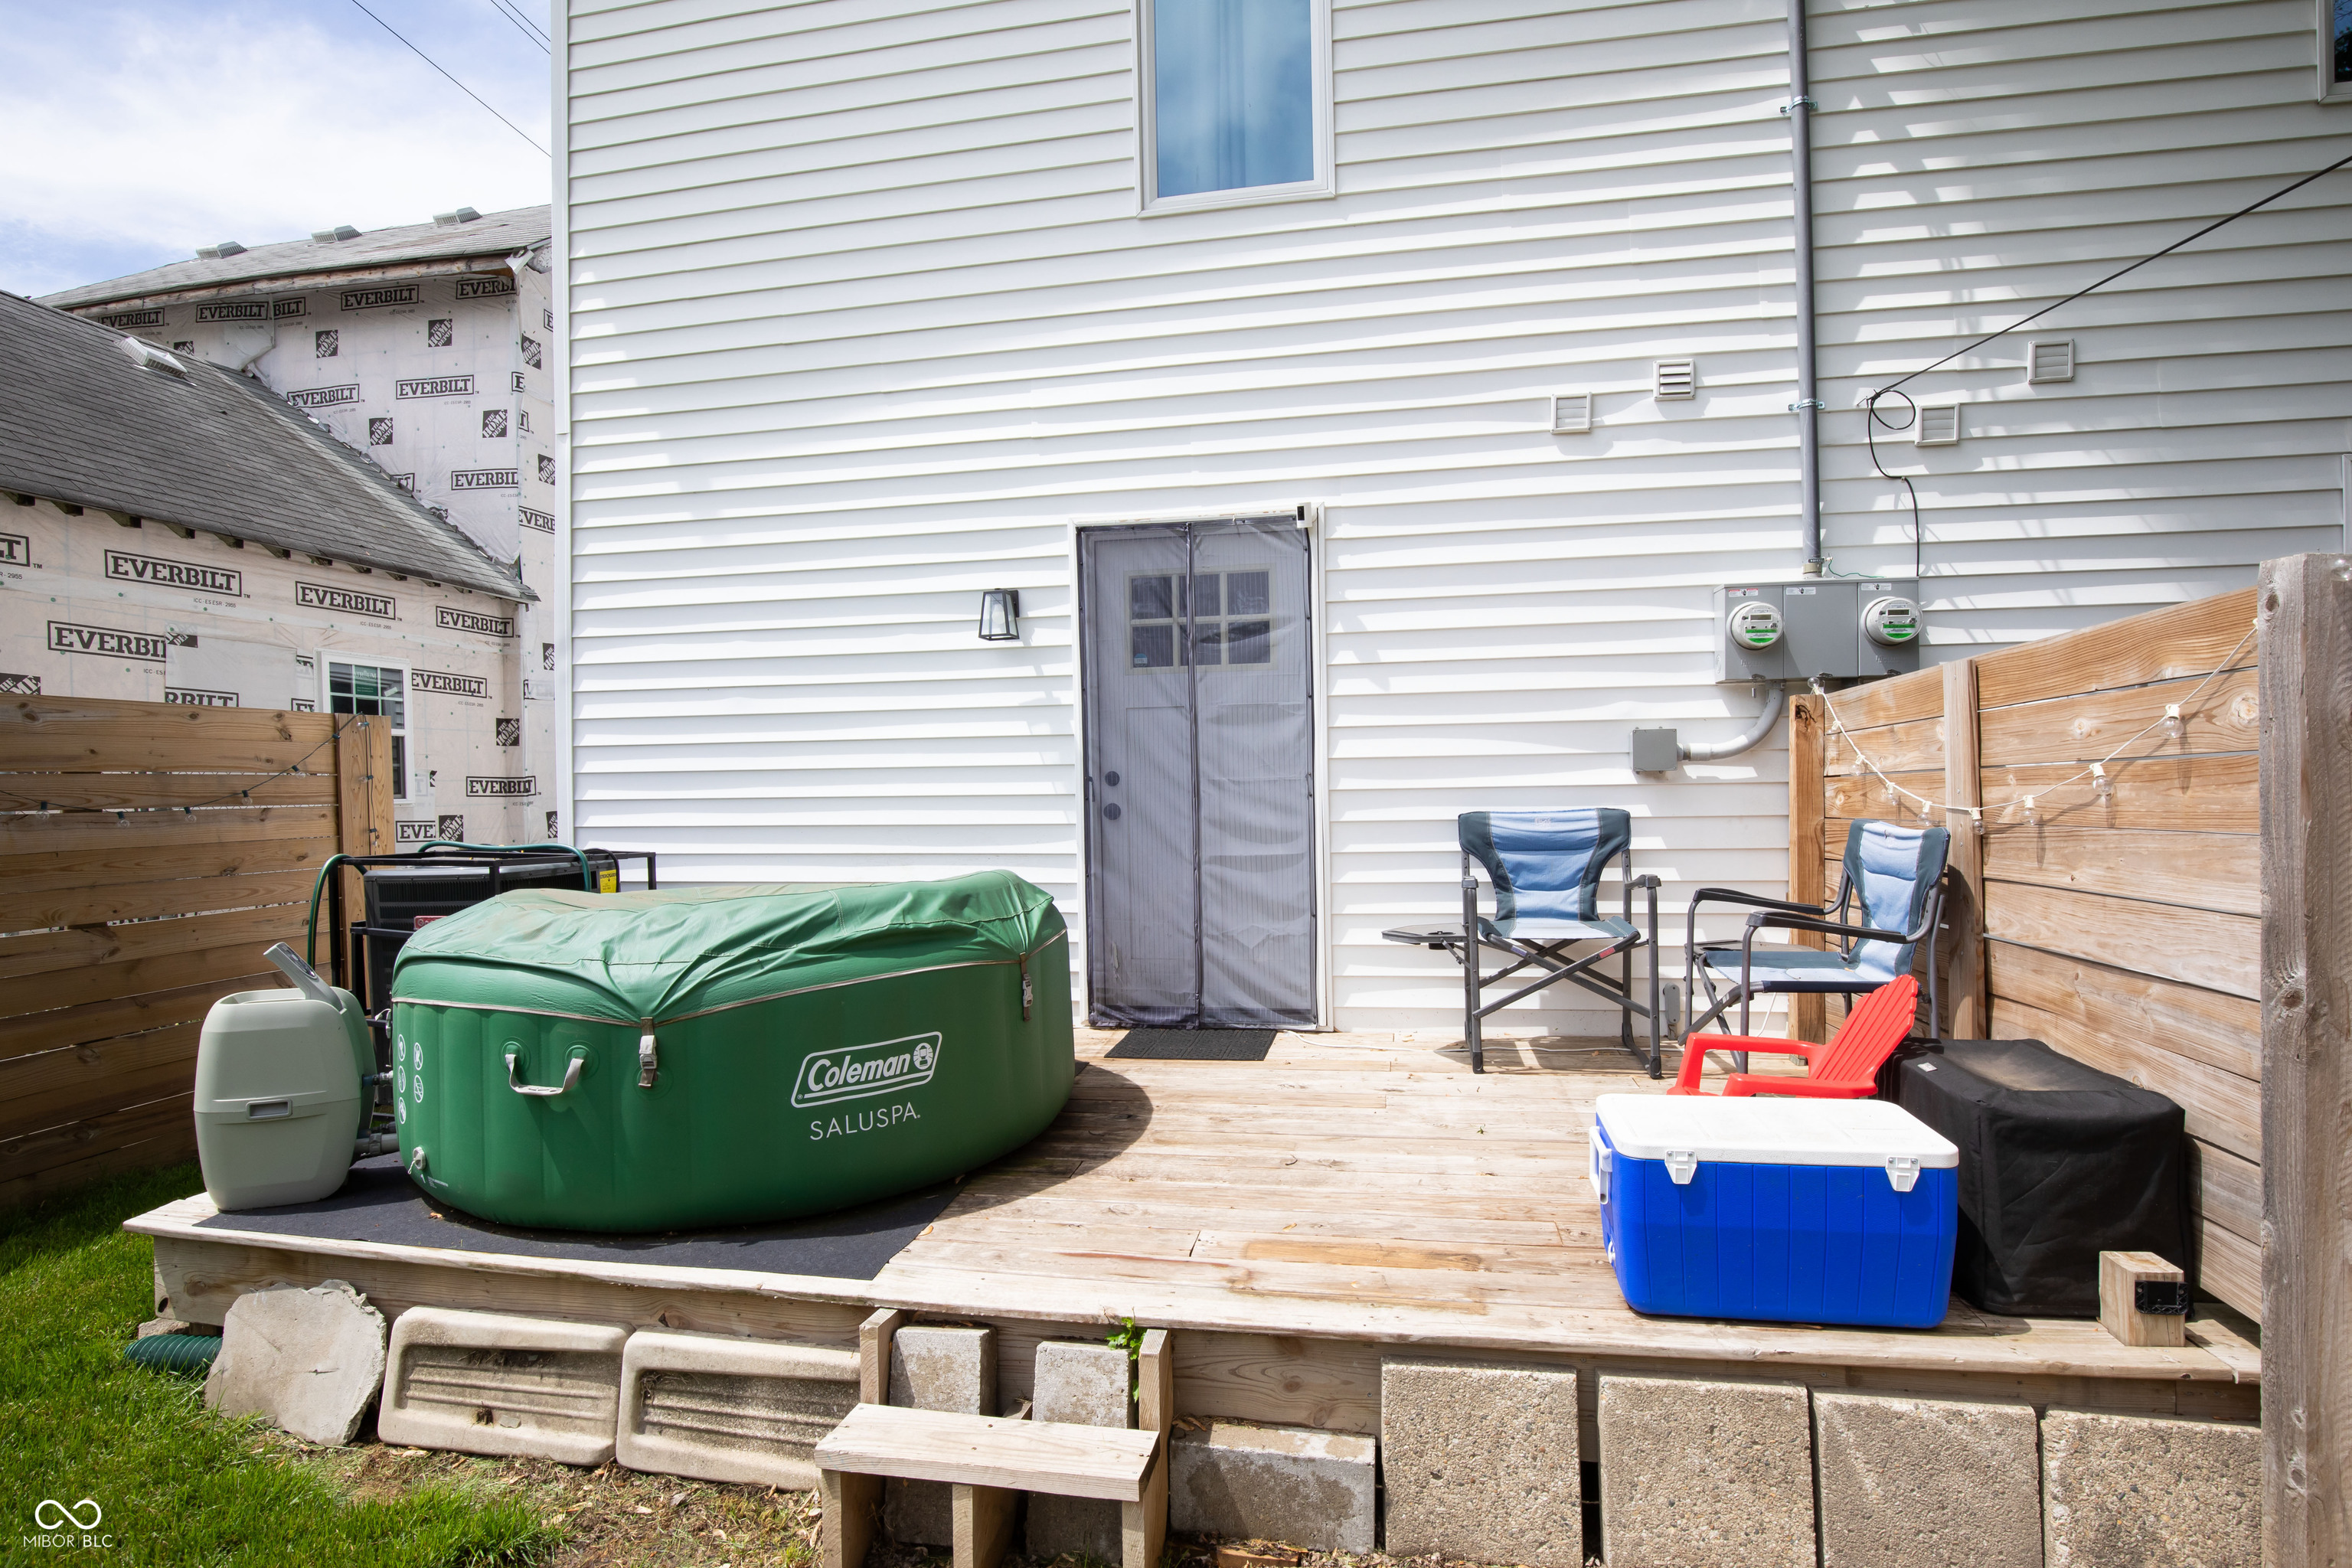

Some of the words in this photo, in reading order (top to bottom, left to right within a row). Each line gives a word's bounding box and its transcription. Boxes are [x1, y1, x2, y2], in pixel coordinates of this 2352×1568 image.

[344, 287, 416, 307] EVERBILT
[100, 311, 162, 328] EVERBILT
[198, 304, 265, 320] EVERBILT
[273, 300, 302, 317] BILT
[428, 318, 452, 347] HOME
[316, 330, 338, 358] HOME
[291, 387, 356, 407] EVERBILT
[399, 378, 471, 397] EVERBILT
[371, 420, 381, 432] THE
[482, 409, 508, 439] HOME
[485, 412, 496, 424] THE
[370, 417, 394, 446] HOME
[454, 471, 519, 487] EVERBIL
[111, 554, 237, 592] EVERBILT
[300, 586, 391, 616] EVERBILT
[439, 609, 511, 635] EVERBILT
[54, 626, 165, 658] EVERBI
[411, 672, 484, 694] EVERBILT
[496, 717, 520, 746] HOME
[498, 720, 508, 732] THE
[807, 1053, 911, 1093] Coleman
